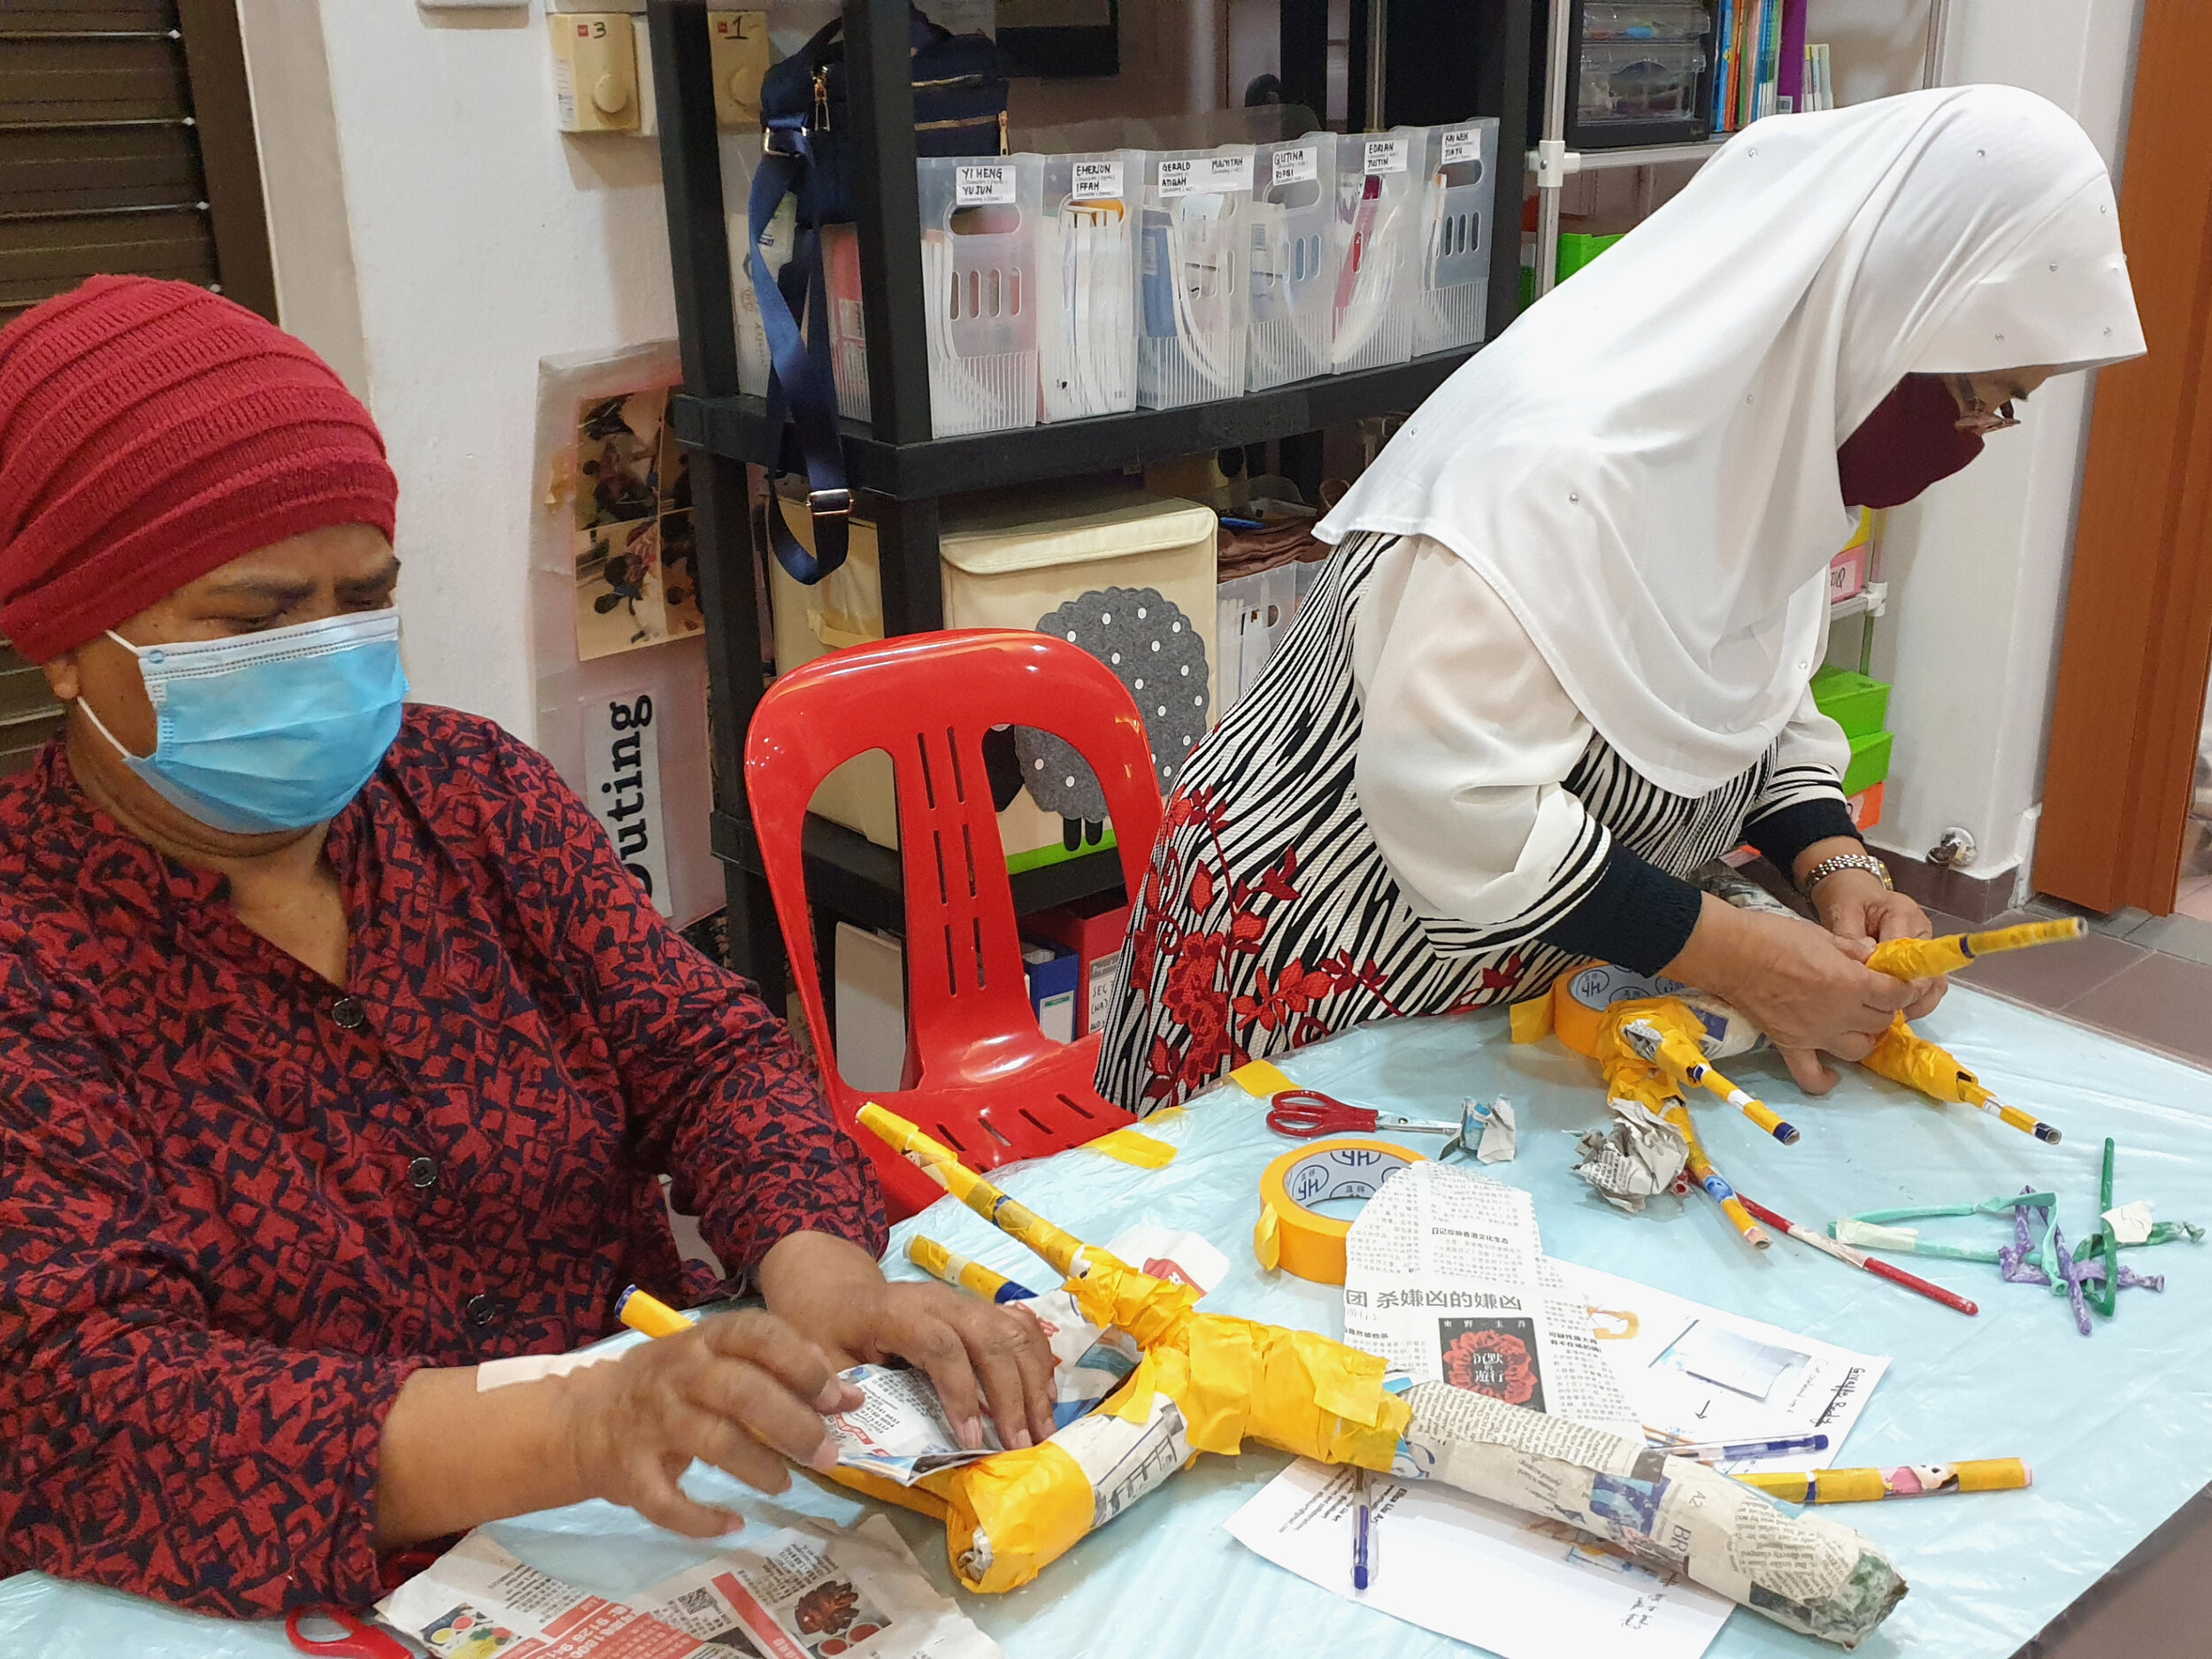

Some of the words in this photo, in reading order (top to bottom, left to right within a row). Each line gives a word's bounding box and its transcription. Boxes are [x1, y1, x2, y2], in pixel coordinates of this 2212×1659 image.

[593, 21, 607, 39] 3
[962, 168, 973, 179] YI
[976, 168, 1002, 180] HENG
[1076, 165, 1111, 176] EMERSON
[1162, 162, 1191, 172] GERALD
[1076, 181, 1099, 193] IFFAH
[1093, 983, 1108, 997] SEC
[1377, 1288, 1523, 1310] 杀嫌凶的嫌凶
[1831, 1367, 1866, 1399] Giraffe
[1688, 1491, 1707, 1508] A2
[1380, 1502, 1394, 1513] Liu
[1670, 1525, 1692, 1552] BR
